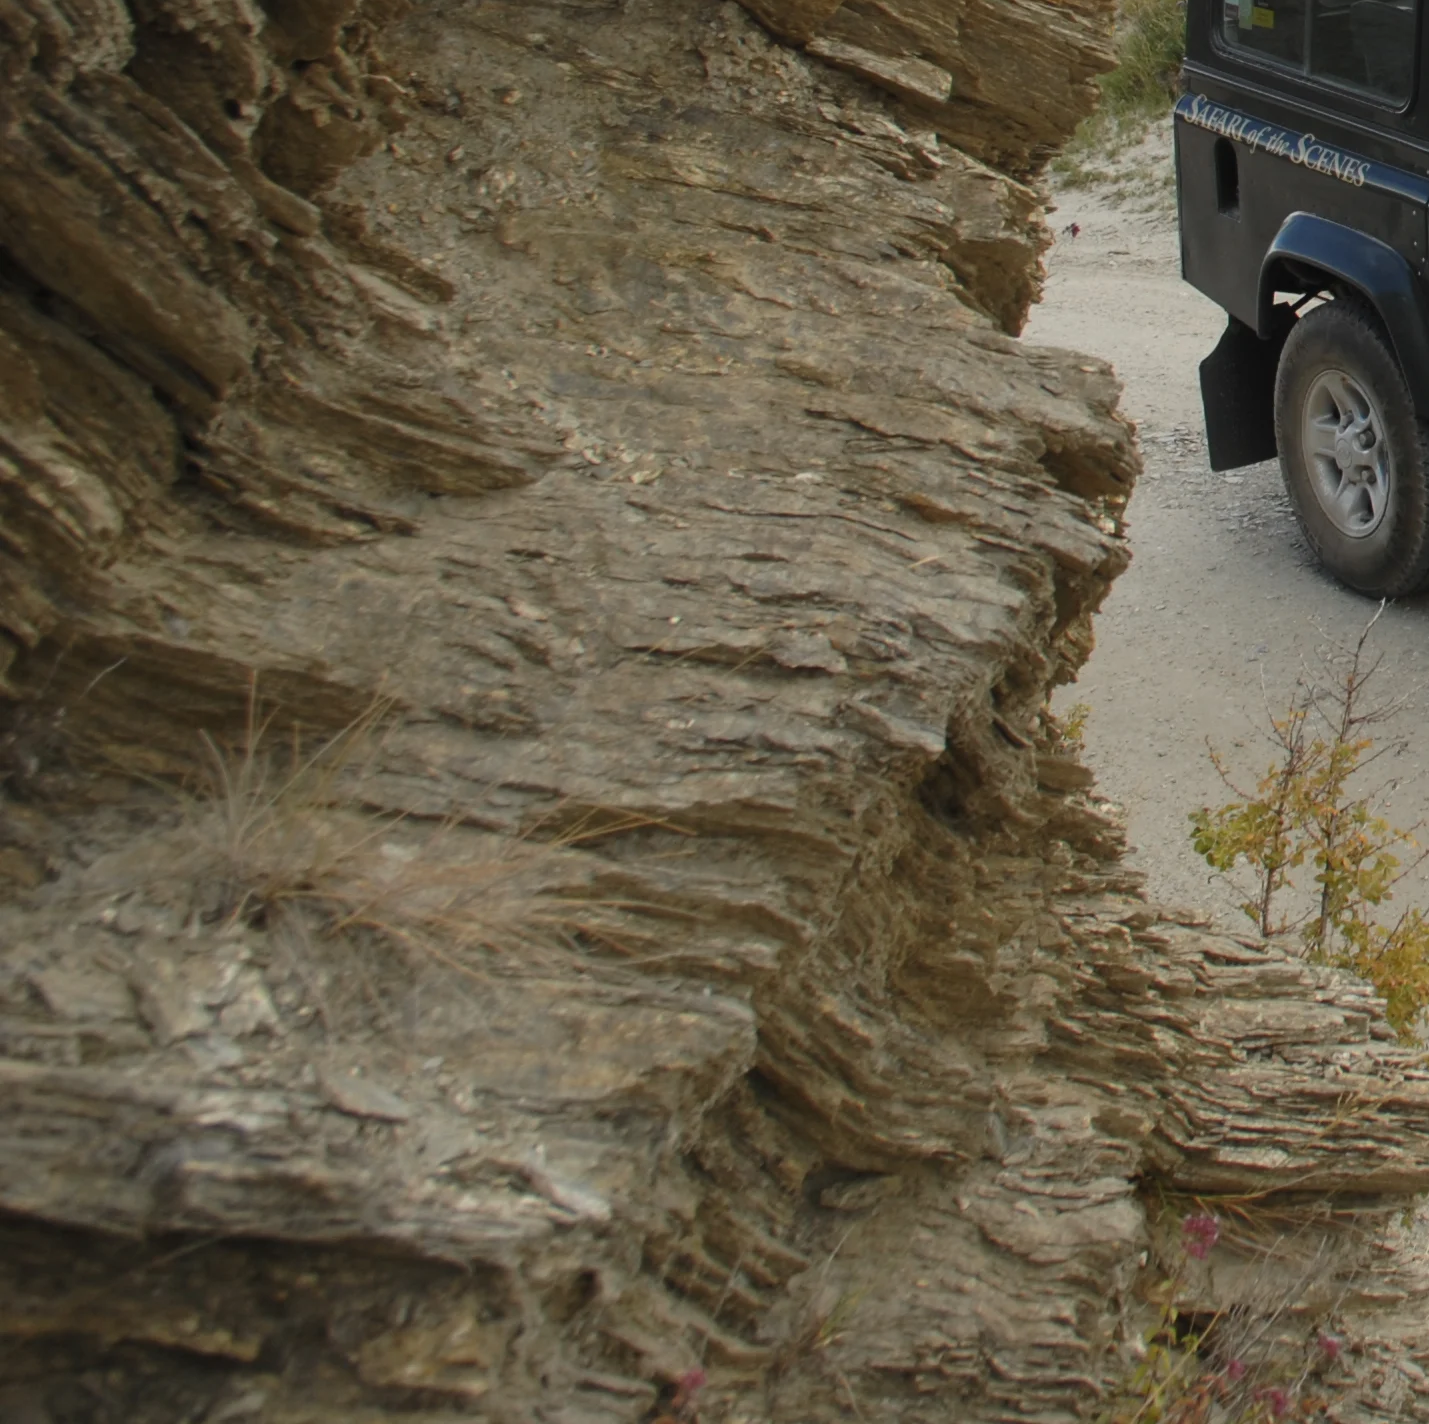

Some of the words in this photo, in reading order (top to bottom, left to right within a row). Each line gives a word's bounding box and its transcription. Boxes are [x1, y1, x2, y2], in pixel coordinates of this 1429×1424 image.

[1183, 93, 1251, 142] SAFARI
[1246, 126, 1271, 154] of
[1265, 131, 1290, 157] the
[1290, 133, 1371, 187] SCENES
